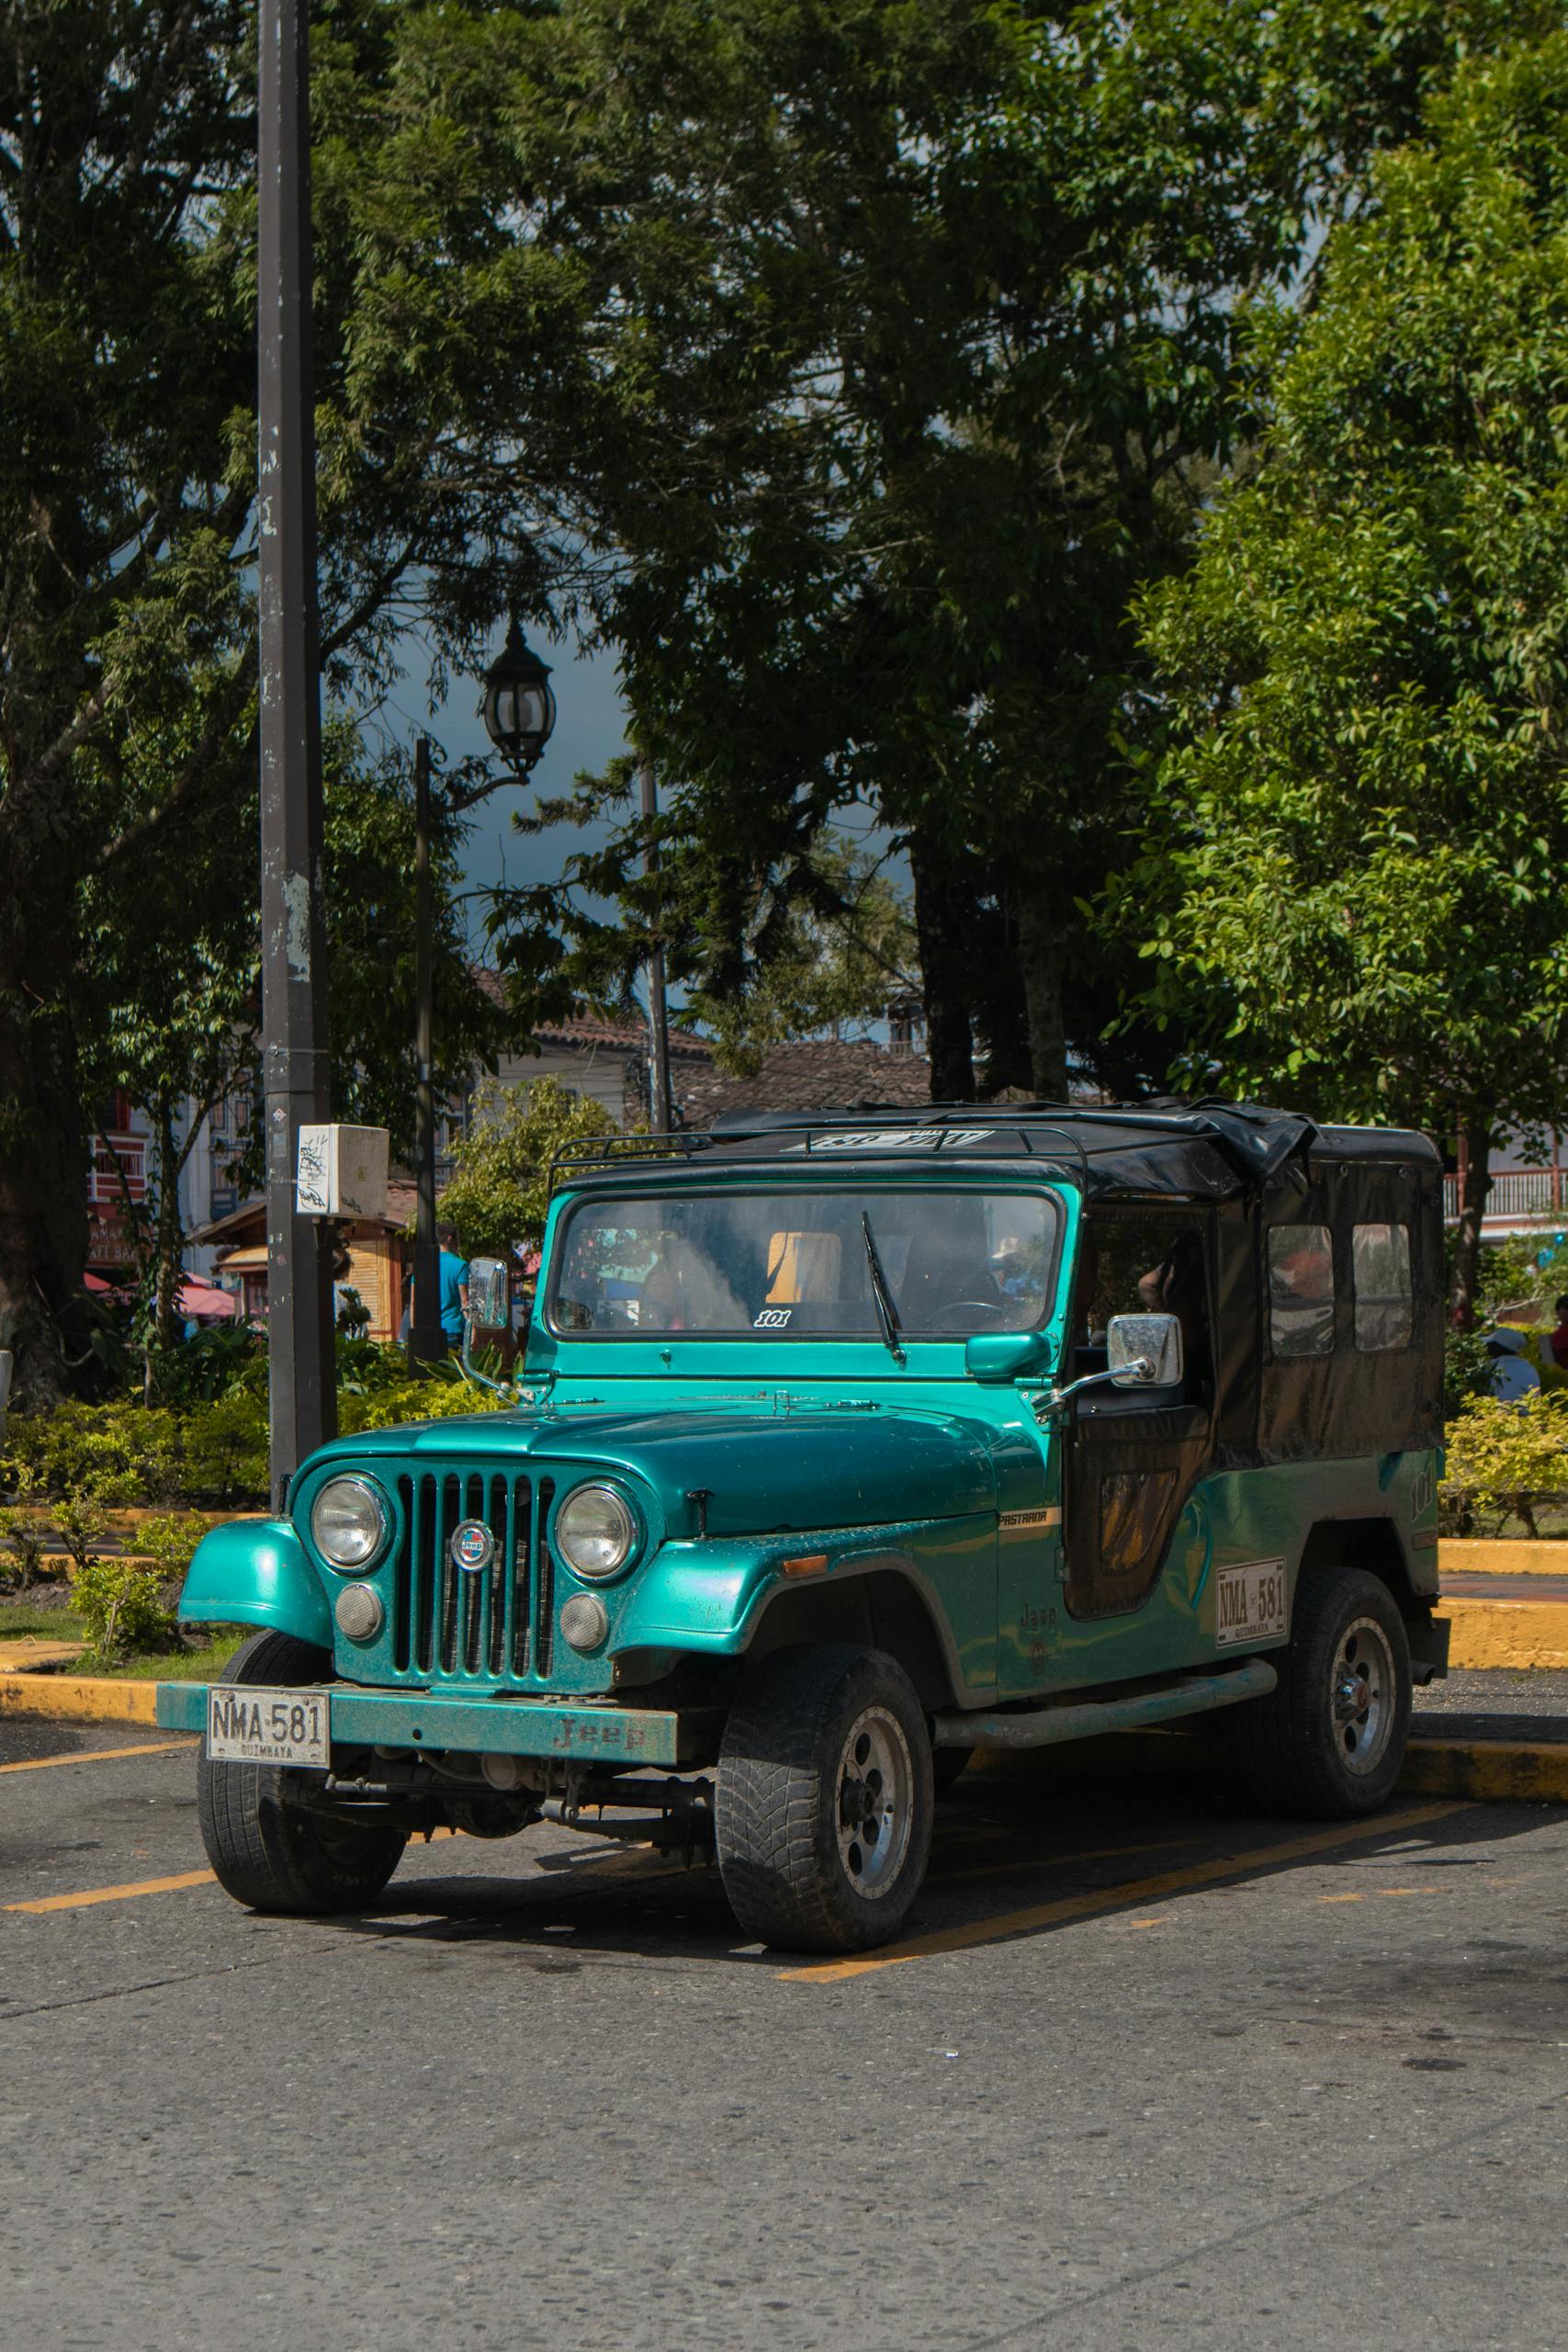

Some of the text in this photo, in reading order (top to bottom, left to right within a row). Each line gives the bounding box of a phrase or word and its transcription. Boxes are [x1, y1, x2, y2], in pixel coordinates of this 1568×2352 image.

[753, 1309, 792, 1328] 101
[998, 1511, 1047, 1526] PASTRANA
[462, 1541, 482, 1550] Jeep
[1219, 1576, 1283, 1629] NMA 581
[213, 1700, 322, 1745] NMA 581
[553, 1719, 646, 1750] Jeep
